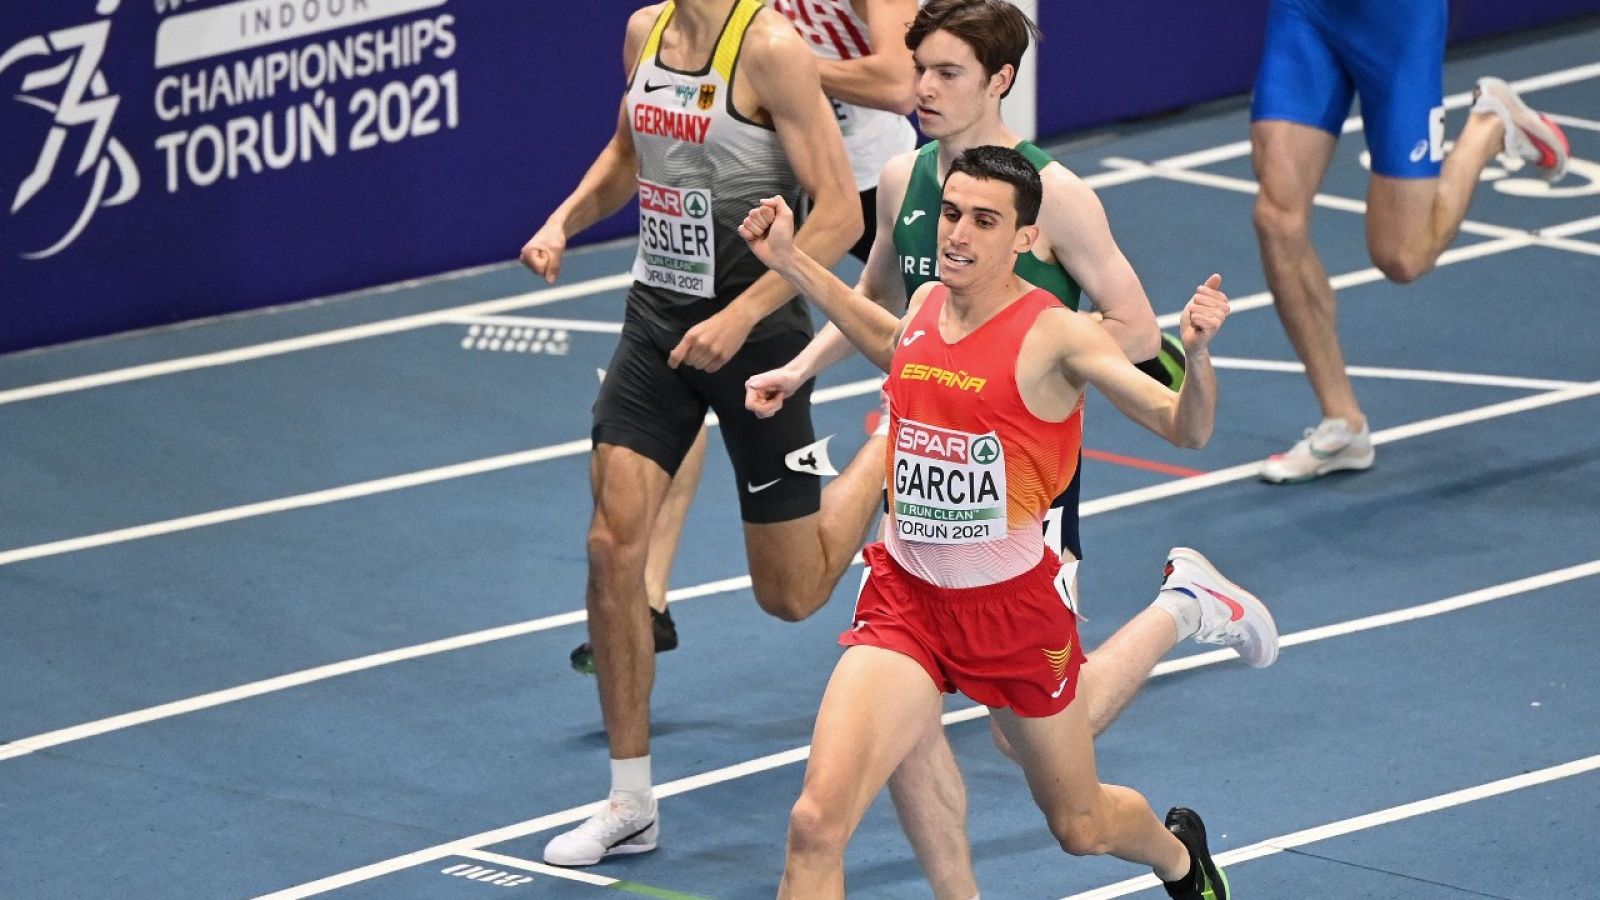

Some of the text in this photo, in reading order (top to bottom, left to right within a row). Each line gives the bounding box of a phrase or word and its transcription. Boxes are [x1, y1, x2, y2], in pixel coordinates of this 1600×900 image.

[154, 14, 457, 121] CHAMPIONSHIPS
[154, 69, 459, 194] TORUŃ 2021
[634, 103, 712, 144] GERMANY
[678, 275, 704, 291] 2021
[900, 362, 987, 393] ESPAÑA
[898, 427, 967, 460] SPAR
[895, 458, 1000, 505] GARCIA
[909, 505, 932, 518] RUN
[897, 519, 990, 540] TORUŃ 2021
